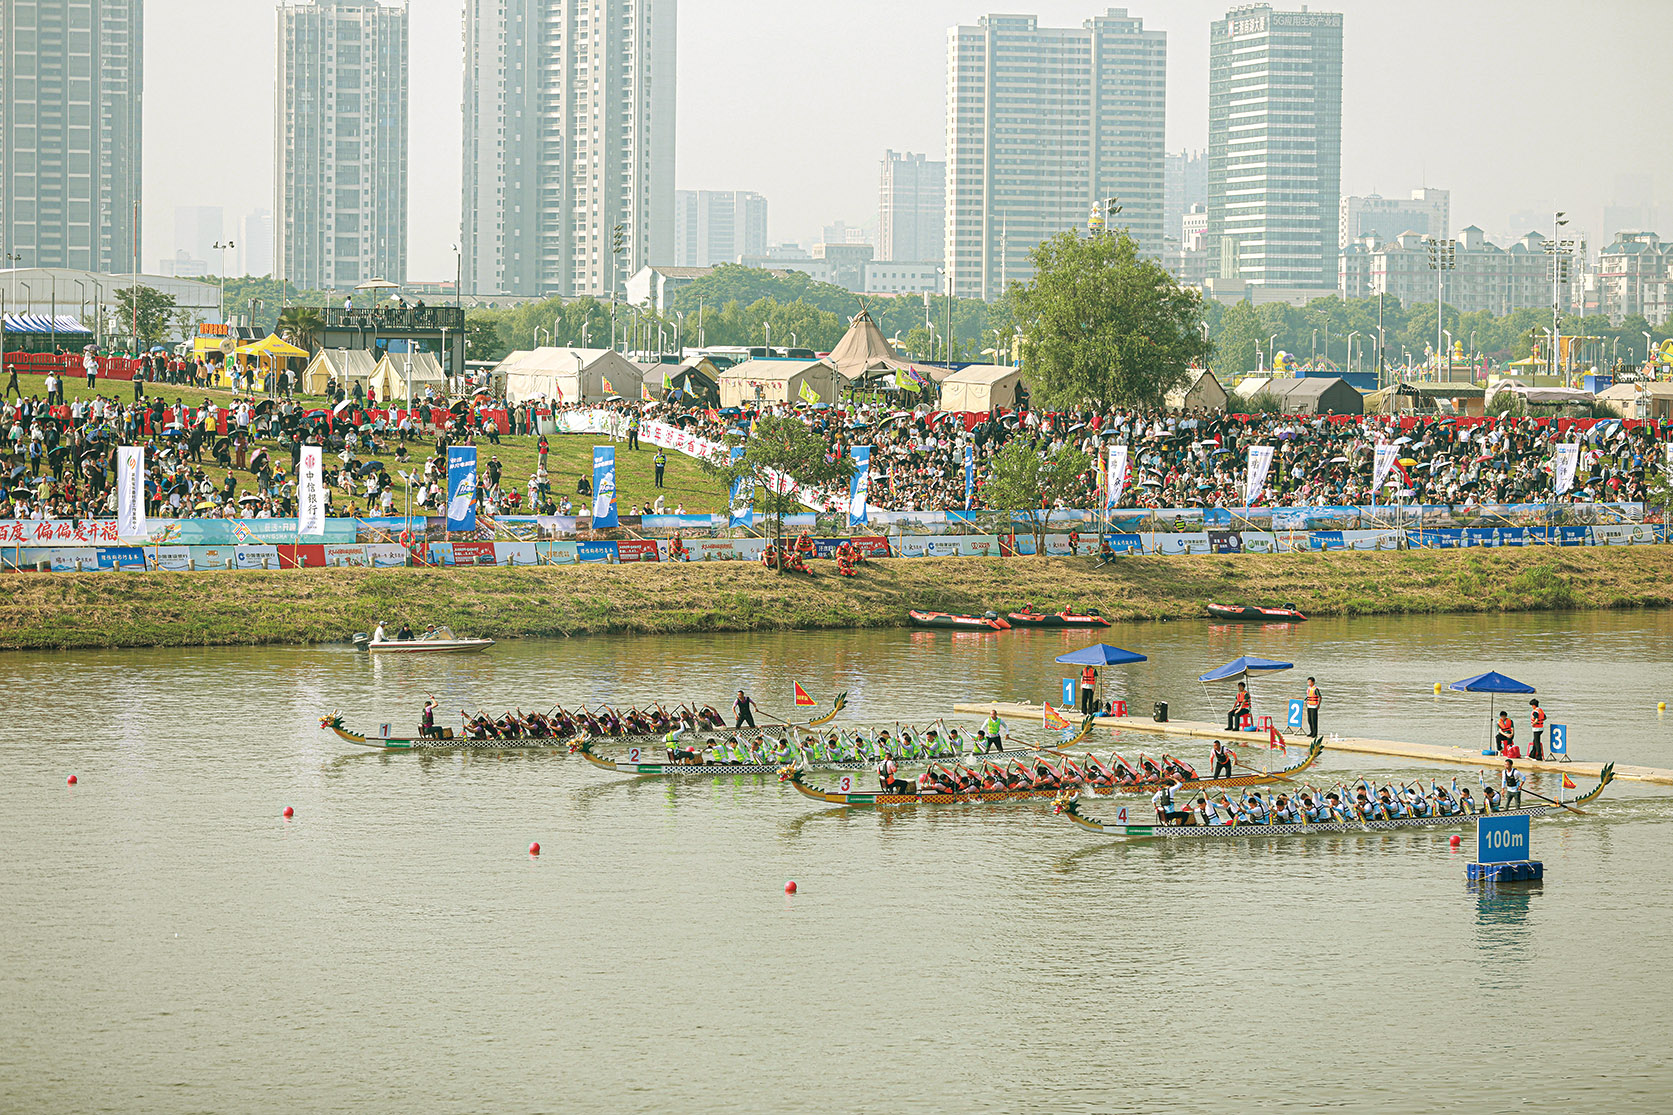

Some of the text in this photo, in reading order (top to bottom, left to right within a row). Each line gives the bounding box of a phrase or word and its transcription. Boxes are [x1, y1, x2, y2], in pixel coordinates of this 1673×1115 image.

[306, 470, 318, 516] 中信银行
[33, 520, 119, 544] 偏偏爱开福
[1065, 682, 1072, 702] 1
[1289, 703, 1300, 724] 2
[382, 724, 389, 737] 1
[1552, 728, 1563, 750] 3
[631, 748, 640, 762] 2
[841, 777, 850, 792] 3
[1118, 808, 1128, 823] 4
[1485, 829, 1524, 849] 100m
